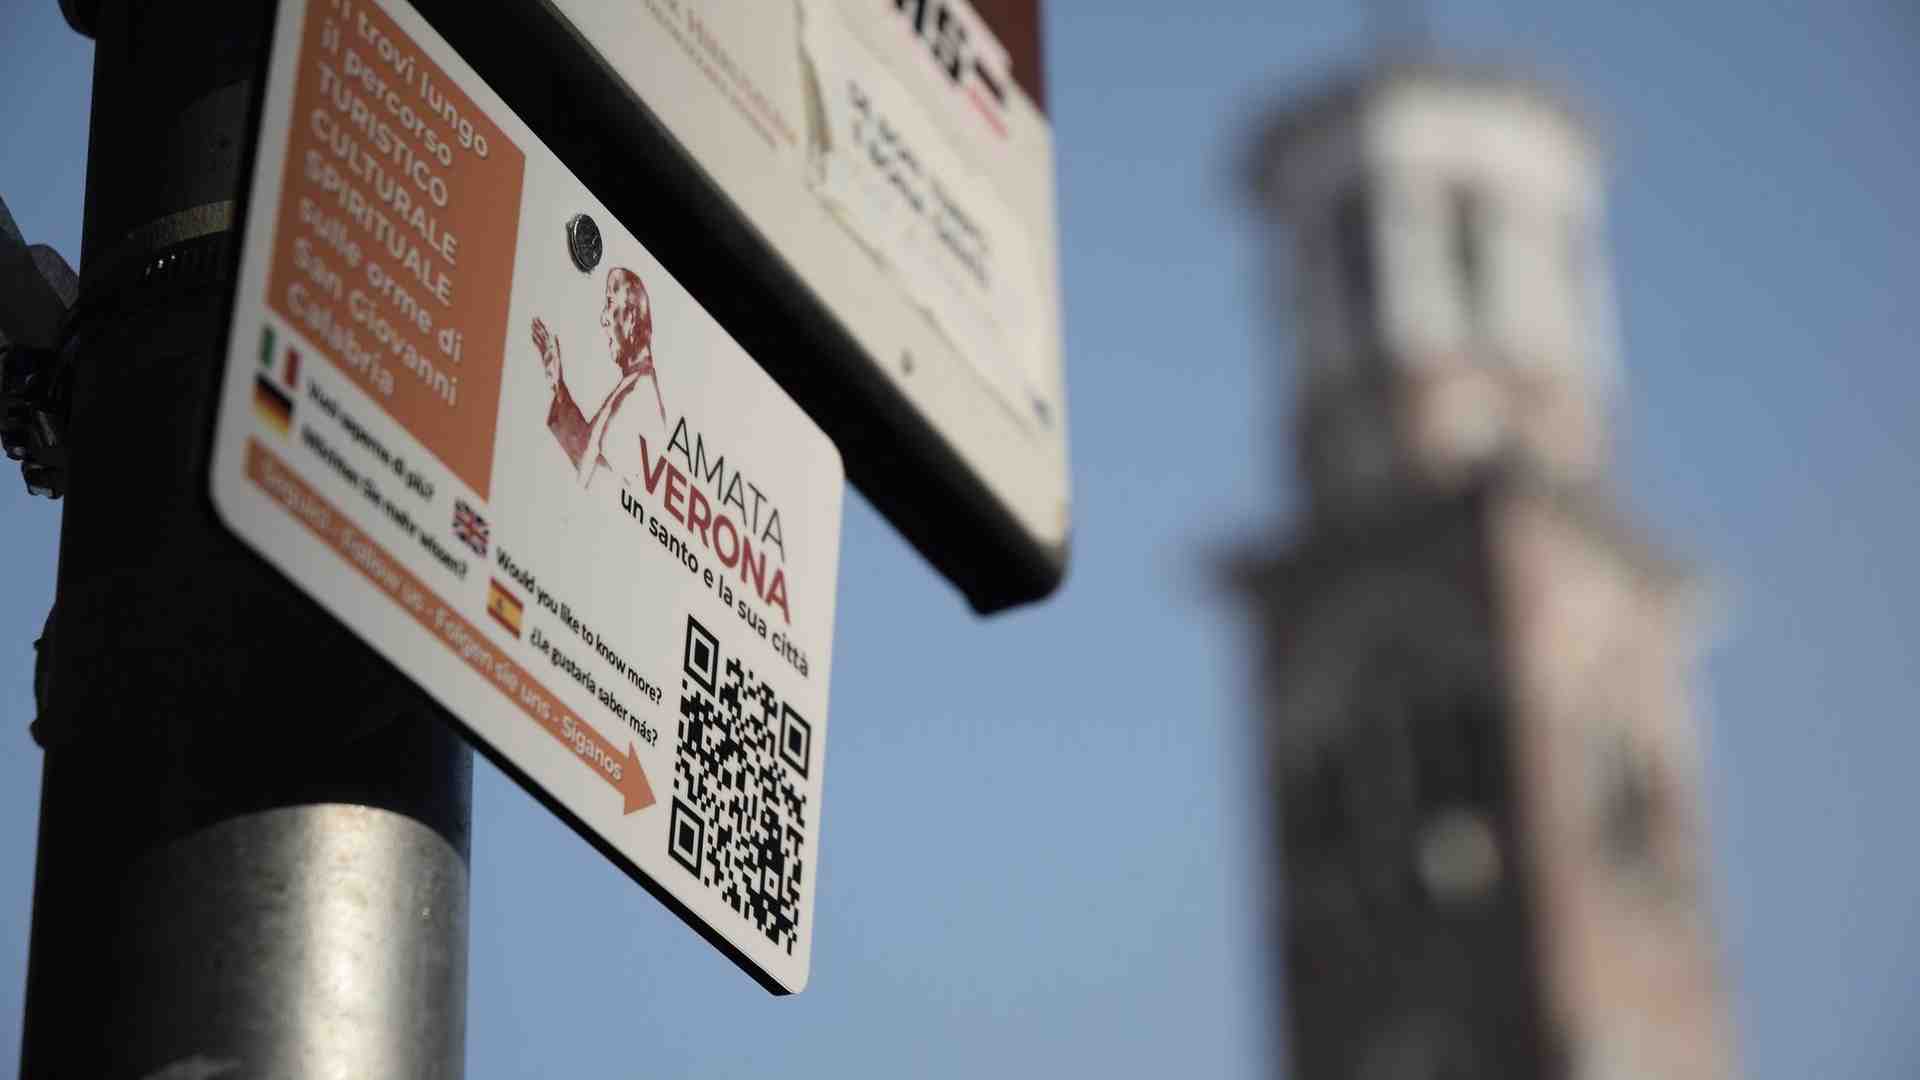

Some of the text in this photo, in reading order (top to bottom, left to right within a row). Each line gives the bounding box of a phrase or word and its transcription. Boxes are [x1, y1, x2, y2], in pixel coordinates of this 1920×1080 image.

[317, 61, 448, 207] TURISTICO
[321, 19, 452, 166] il percorso
[358, 11, 415, 83] trovi
[420, 72, 488, 157] lungo
[304, 150, 452, 306] SPIRITUALE
[311, 108, 457, 265] CULTURALE
[287, 281, 395, 399] Calabria
[294, 237, 457, 407] San Giovanni
[301, 198, 463, 363] sulle orme di
[639, 433, 791, 625] VERONA
[667, 415, 787, 563] AMATA
[496, 546, 663, 705] Would you like to know more?
[620, 488, 810, 680] un santo e la sua città
[530, 627, 659, 748] ¿Le gustaría saber más?
